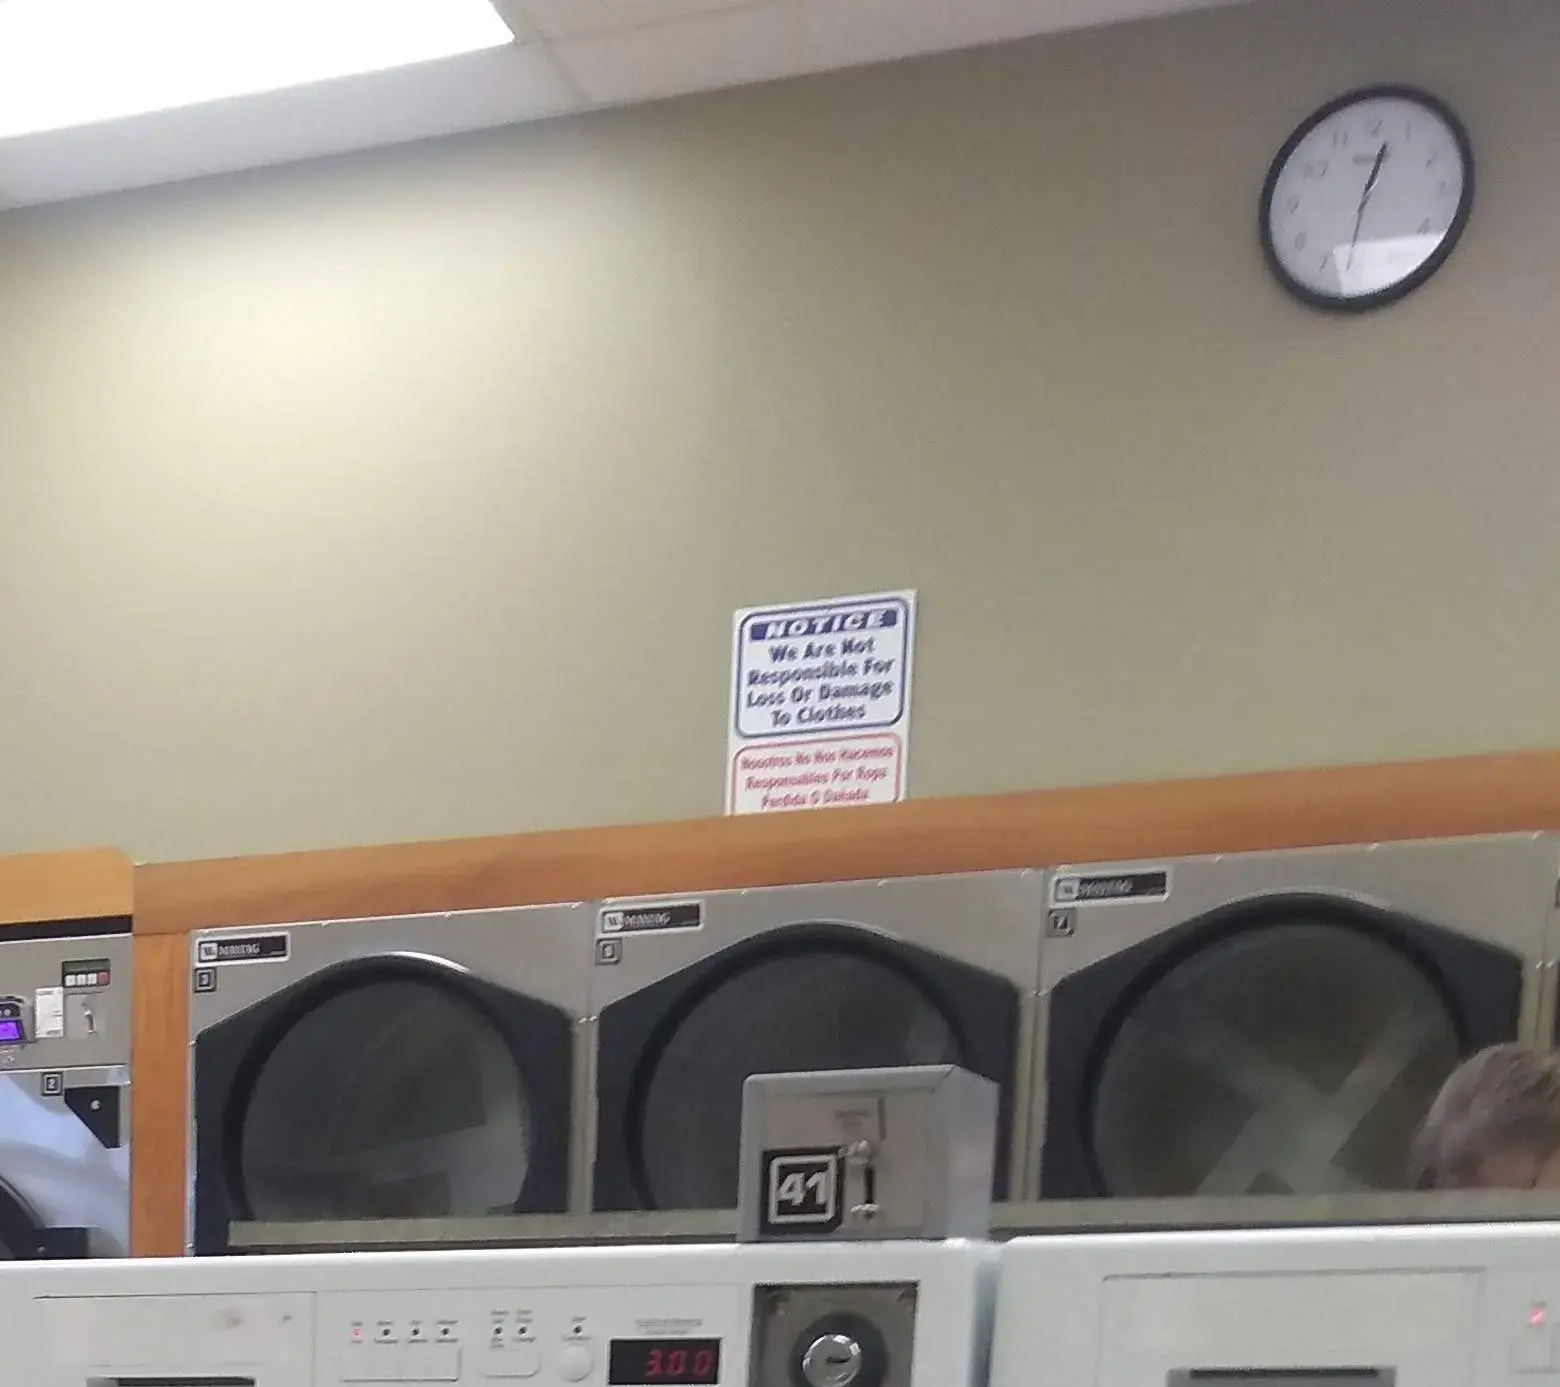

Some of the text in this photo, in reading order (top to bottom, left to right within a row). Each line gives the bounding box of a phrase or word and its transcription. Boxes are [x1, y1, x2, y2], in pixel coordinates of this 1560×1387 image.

[767, 609, 884, 639] NOTICE
[769, 636, 875, 662] We Are Not
[747, 657, 894, 687] Responsible For
[746, 681, 894, 708] Loss Or Damage
[771, 704, 866, 727] To Clothes
[778, 1170, 829, 1206] 41
